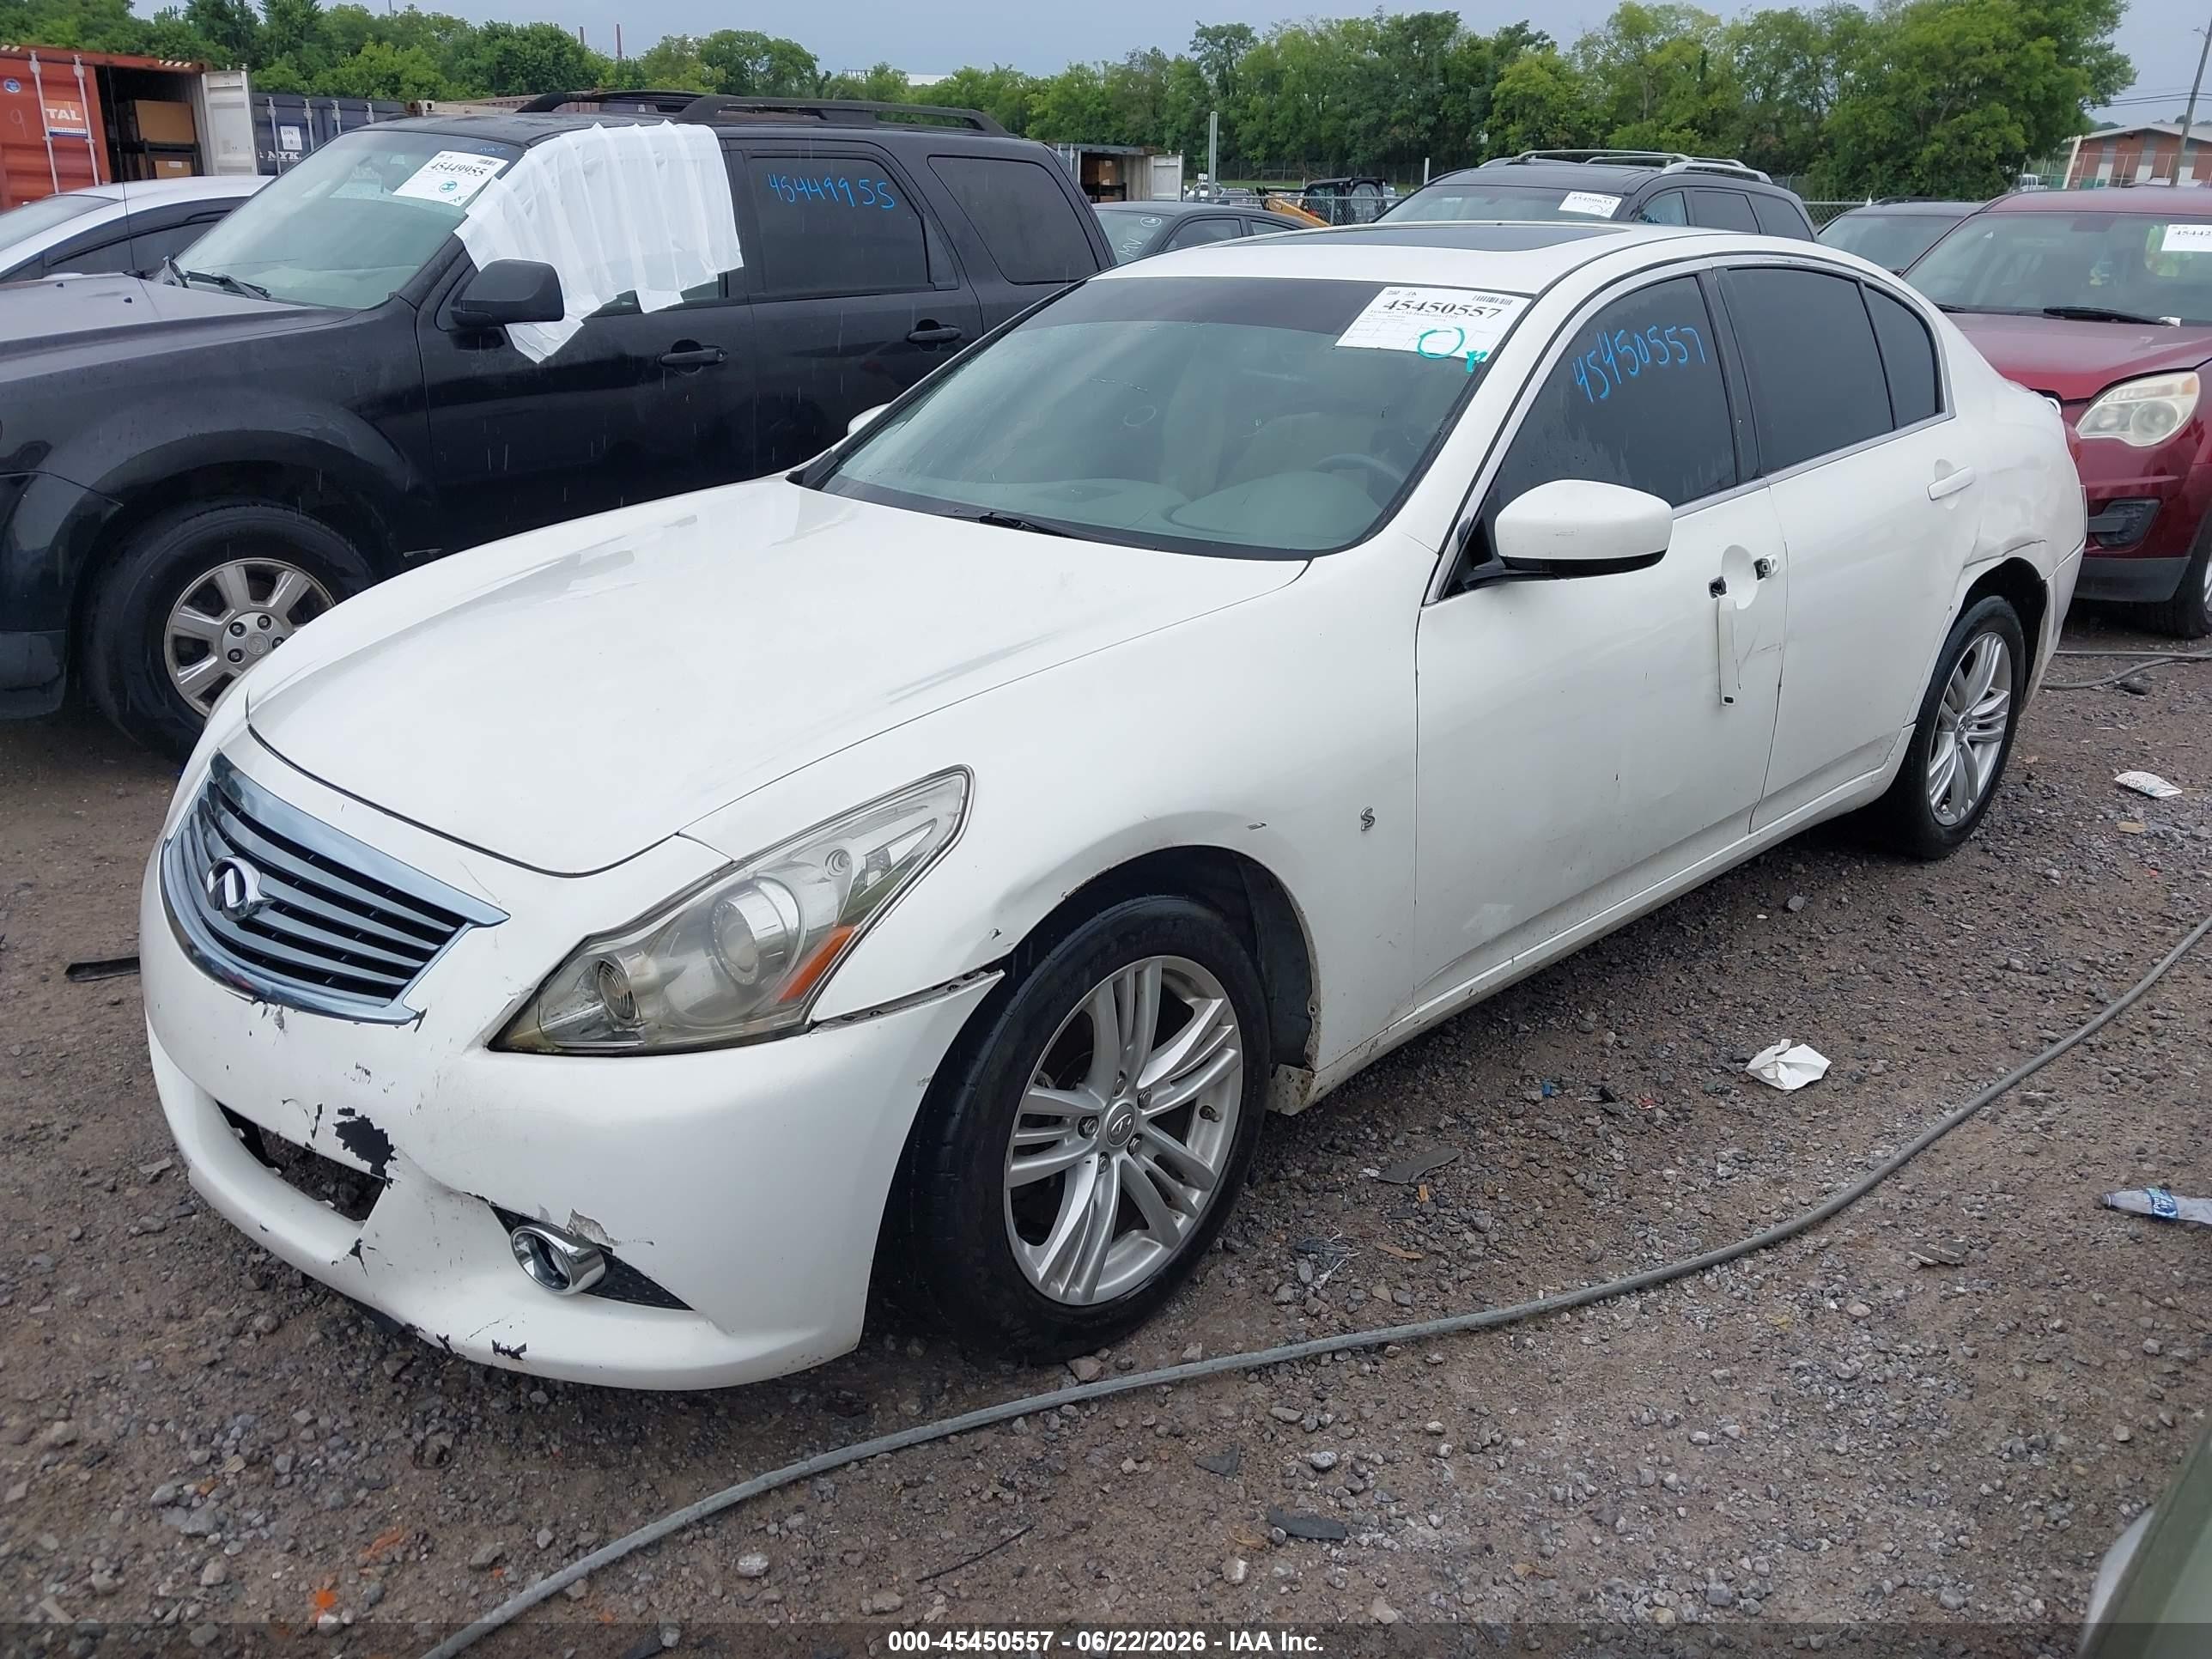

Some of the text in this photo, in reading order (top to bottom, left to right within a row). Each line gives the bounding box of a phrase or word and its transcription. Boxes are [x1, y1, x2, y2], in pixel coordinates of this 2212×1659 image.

[46, 108, 82, 120] TAL
[267, 150, 300, 160] NYK
[767, 173, 895, 210] 45449955
[1382, 298, 1503, 320] 45450557
[1572, 325, 1706, 404] 45450557
[1360, 806, 1376, 831] S
